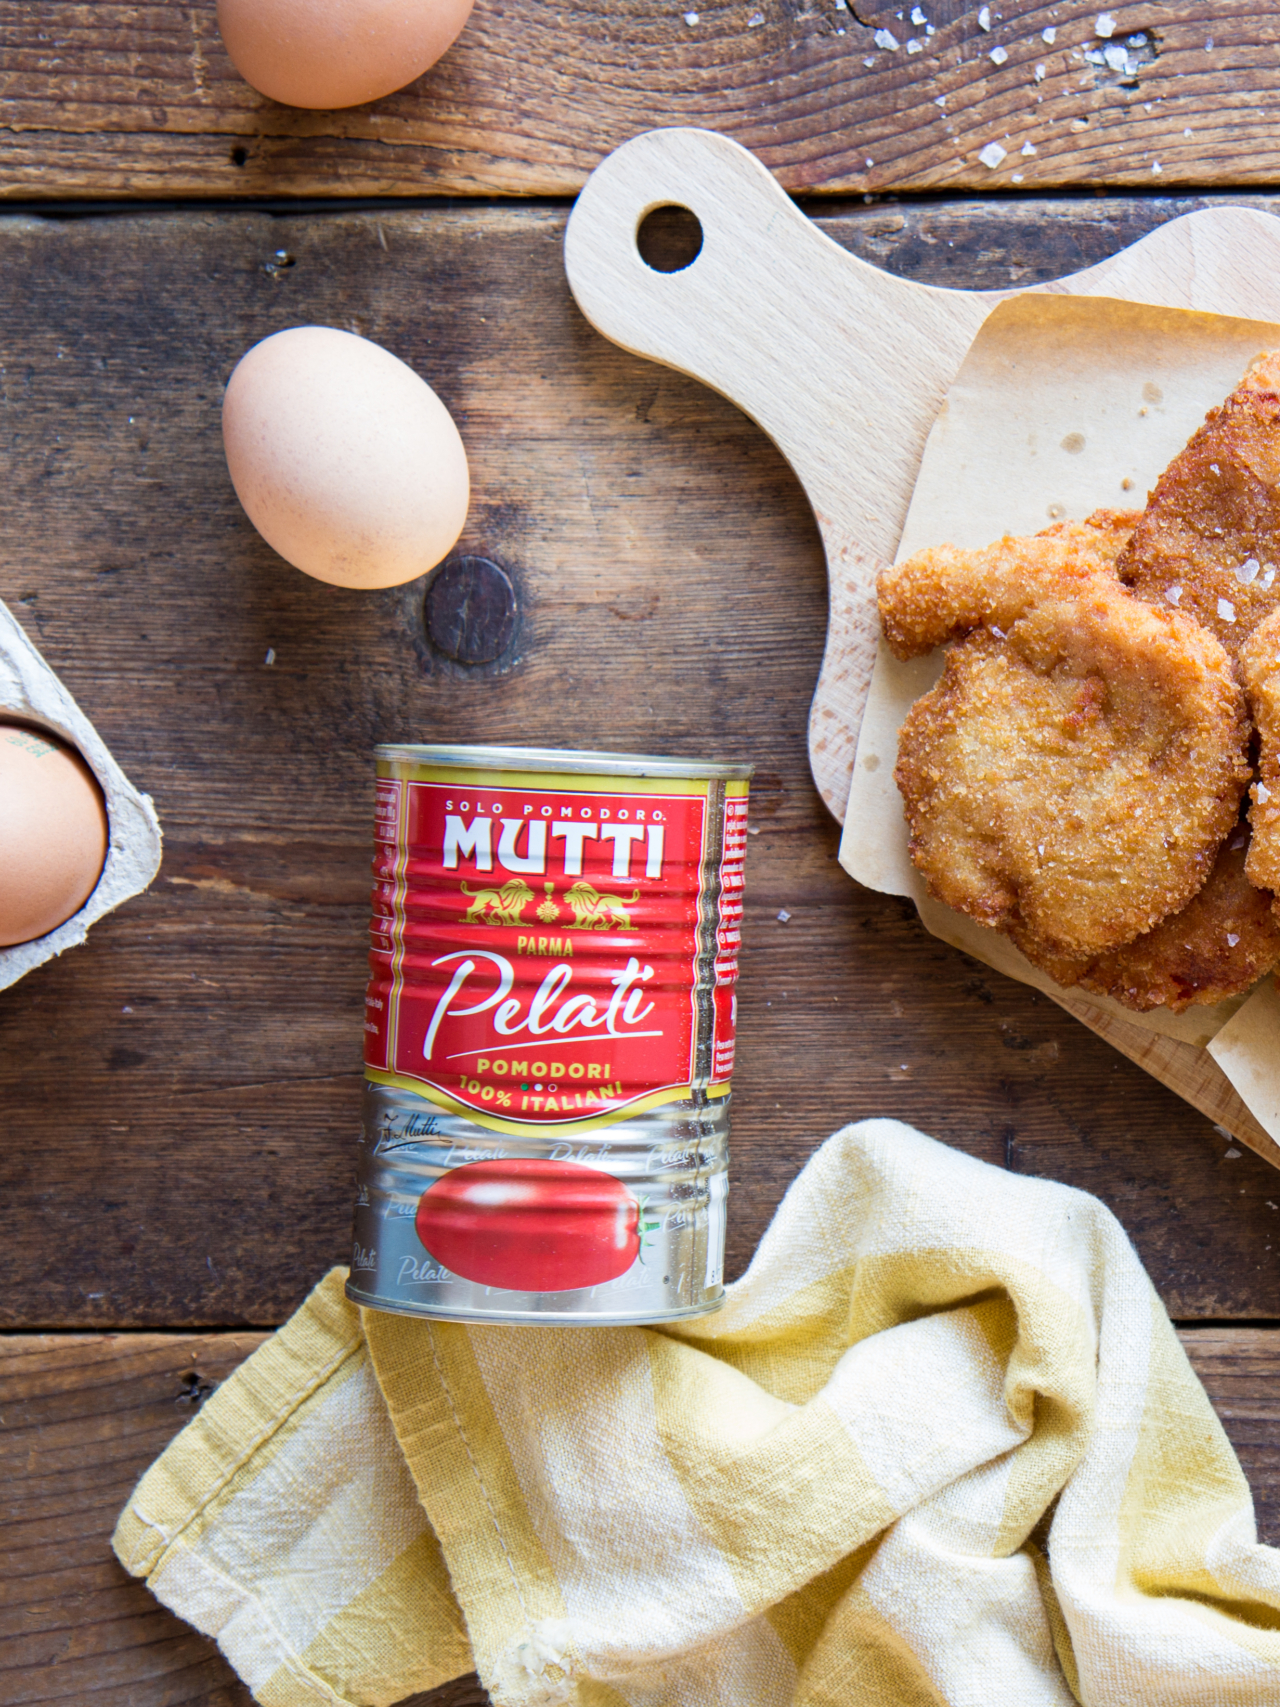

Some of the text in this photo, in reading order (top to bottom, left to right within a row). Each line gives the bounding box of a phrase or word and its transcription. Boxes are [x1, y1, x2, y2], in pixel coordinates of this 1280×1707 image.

[444, 799, 504, 814] SOLO
[442, 814, 666, 881] MUTTI
[516, 934, 574, 958] PARMA
[422, 949, 664, 1061] Pelati
[476, 1057, 611, 1080] POMODORI
[458, 1075, 624, 1113] 100% ITALIANI
[396, 1254, 454, 1286] Pelati
